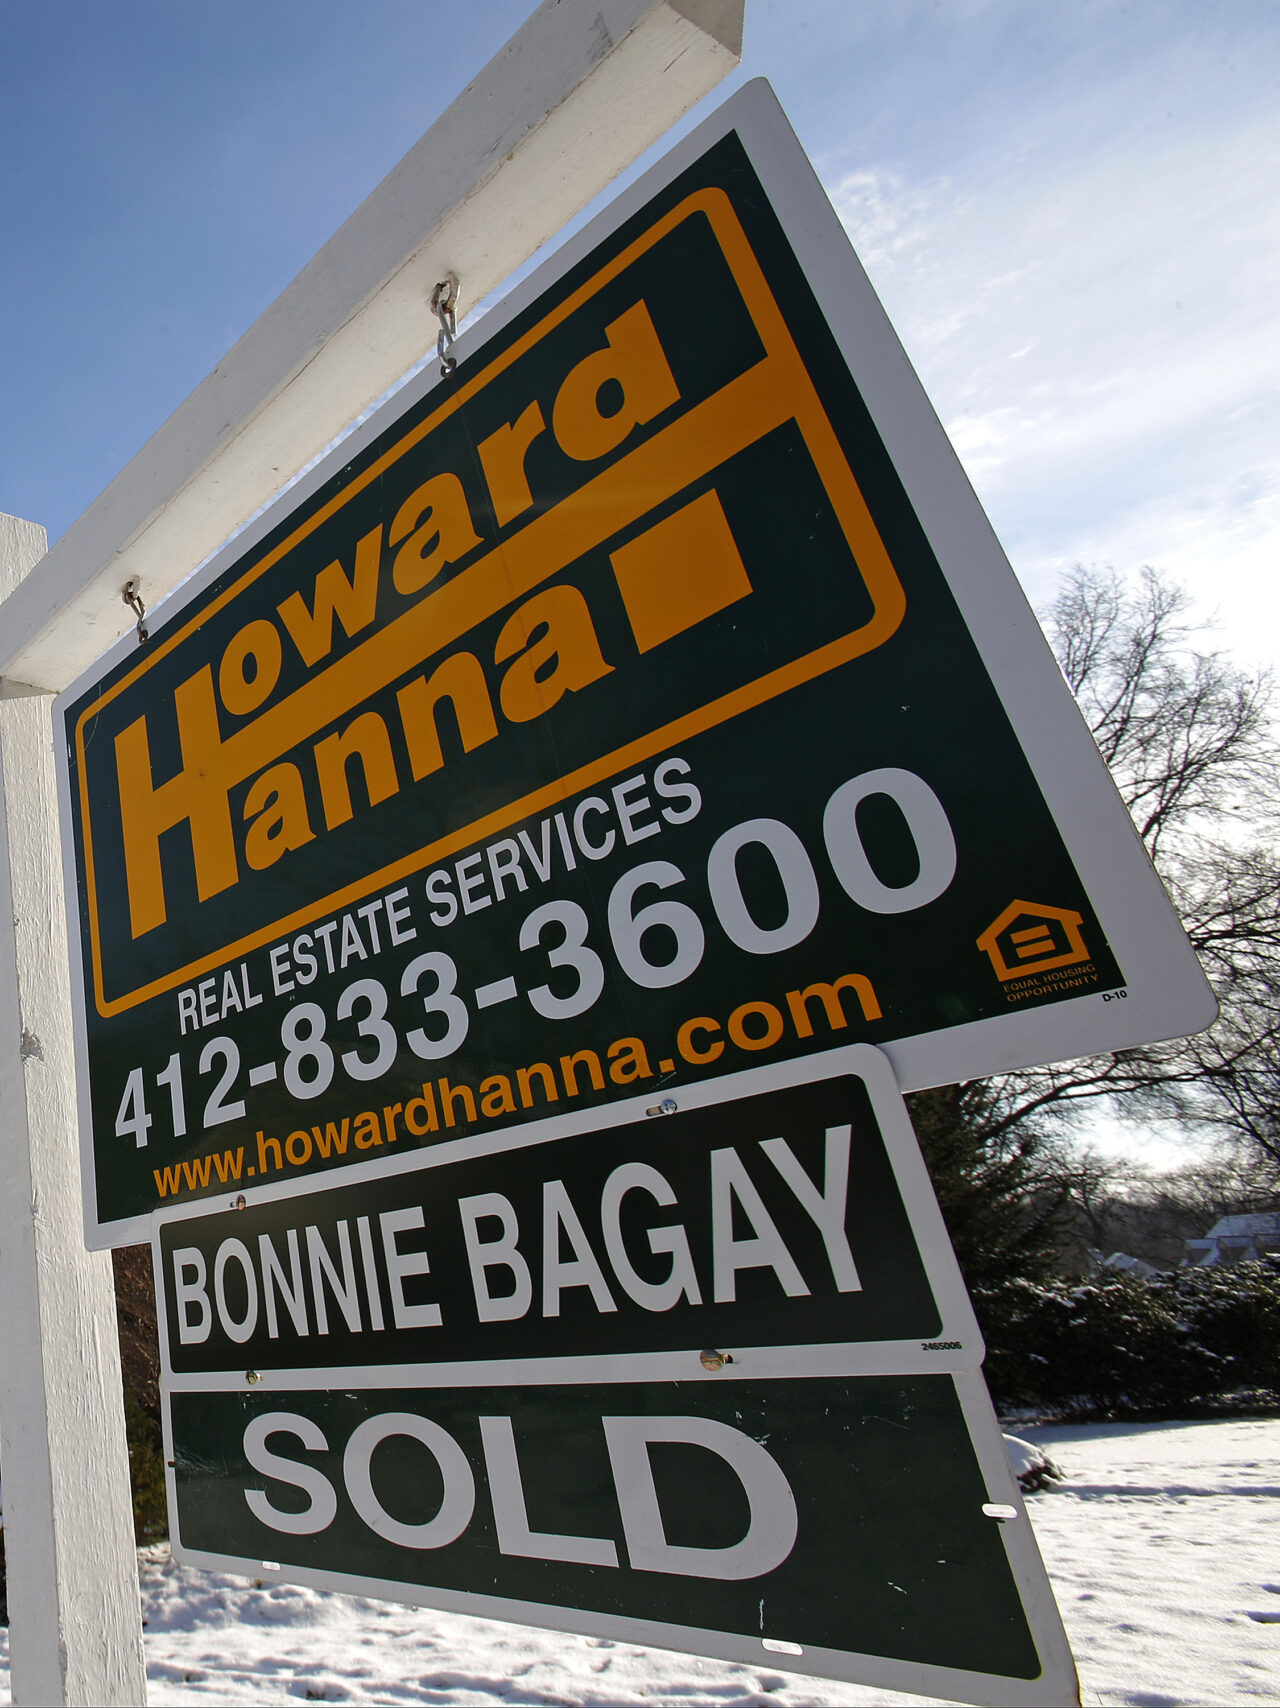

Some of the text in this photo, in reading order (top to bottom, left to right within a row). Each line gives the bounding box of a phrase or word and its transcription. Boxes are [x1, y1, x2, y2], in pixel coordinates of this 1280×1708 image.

[114, 299, 681, 939] Howard
[114, 585, 616, 939] Hanna
[115, 768, 956, 1148] 412-833-3600
[178, 758, 701, 1035] REAL ESTATE SERVICES
[1004, 963, 1096, 993] EQUAL HOUSING
[1007, 973, 1099, 1002] OPPORTUNITY
[1102, 989, 1127, 1002] D-10
[153, 974, 882, 1197] www.howardhanna.com
[173, 1124, 862, 1344] BONNIE BAGAY
[243, 1412, 798, 1580] SOLD
